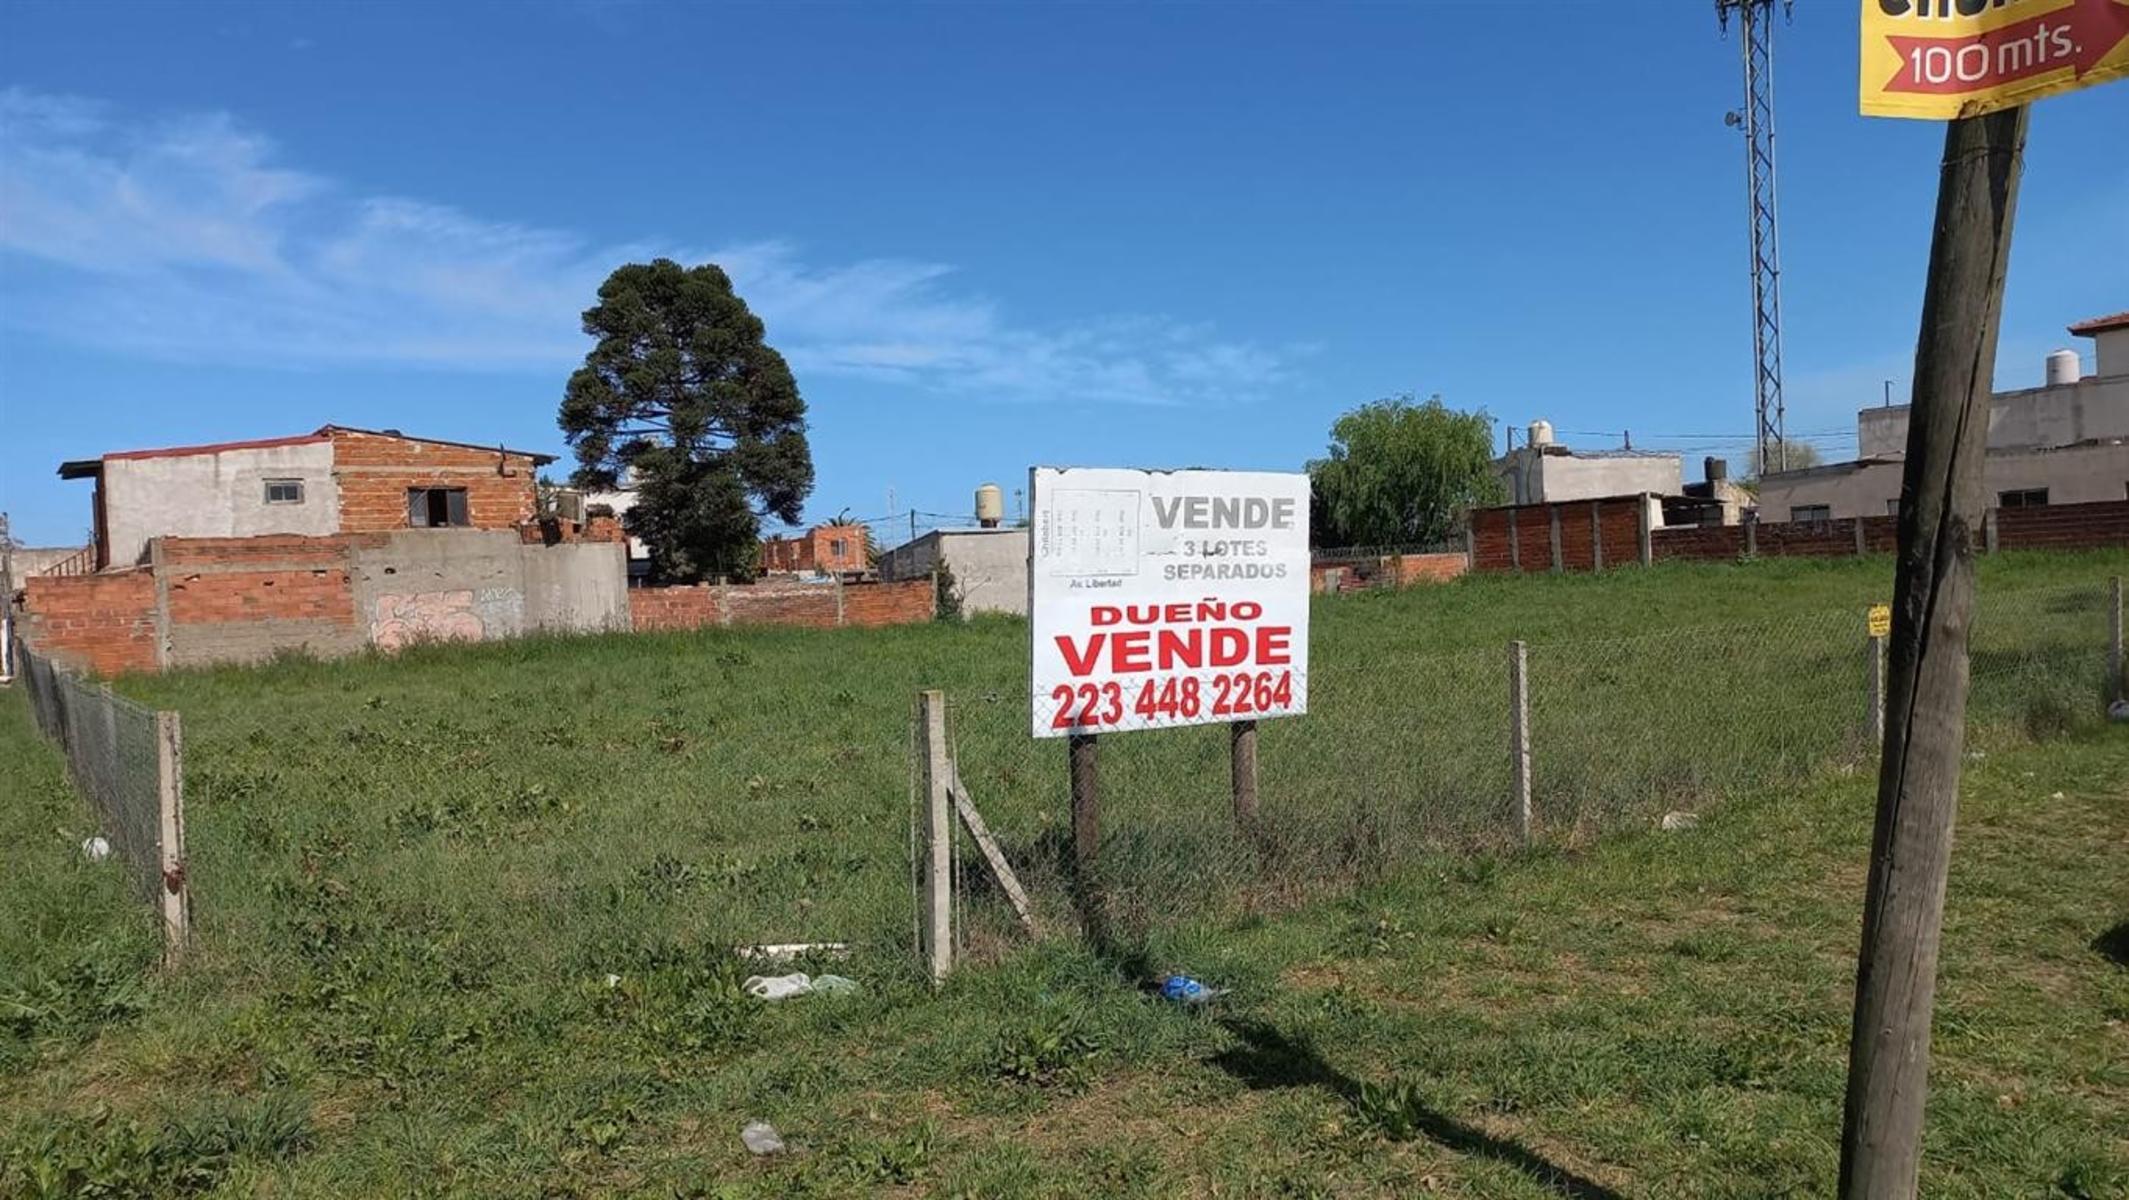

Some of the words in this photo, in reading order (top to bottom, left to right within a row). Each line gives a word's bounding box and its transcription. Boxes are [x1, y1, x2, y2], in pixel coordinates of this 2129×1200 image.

[1910, 44, 1990, 84] 100
[1997, 22, 2083, 75] mts.
[1150, 496, 1295, 530] VENDE
[1183, 540, 1195, 557] 3
[1202, 539, 1268, 558] LOTES
[1085, 578, 1123, 589] Libertad
[1163, 563, 1288, 581] SEPARADOS
[1090, 596, 1263, 626] DUEÑO
[1054, 626, 1293, 677] VENDE
[1051, 681, 1123, 729] 223
[1135, 675, 1201, 721] 448
[1211, 670, 1293, 716] 2264
